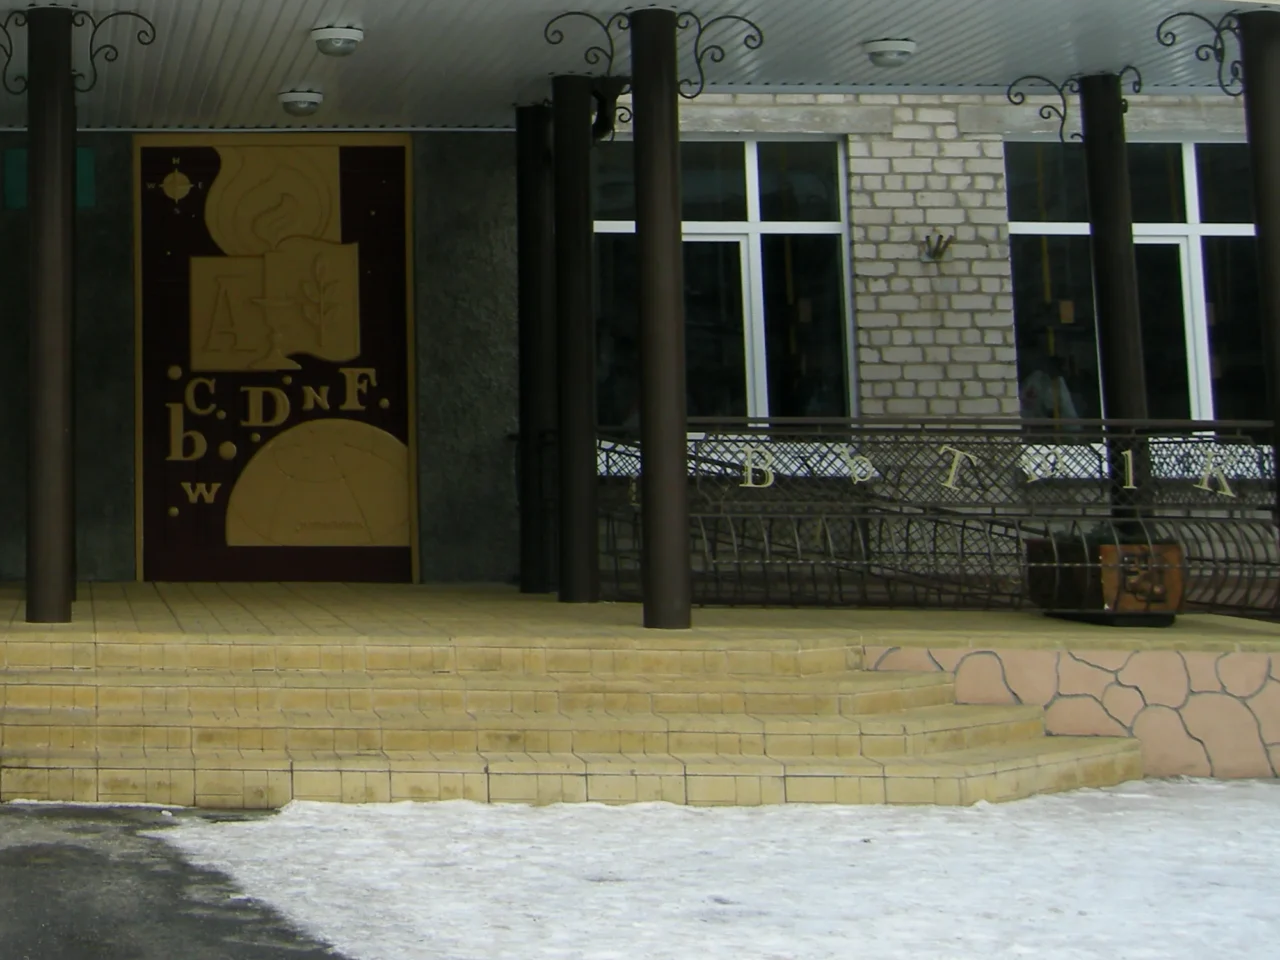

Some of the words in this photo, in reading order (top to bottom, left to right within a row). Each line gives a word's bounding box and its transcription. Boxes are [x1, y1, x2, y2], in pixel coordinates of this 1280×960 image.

[184, 377, 218, 416] C
[239, 385, 291, 428] D
[338, 367, 378, 411] F
[165, 402, 208, 462] b
